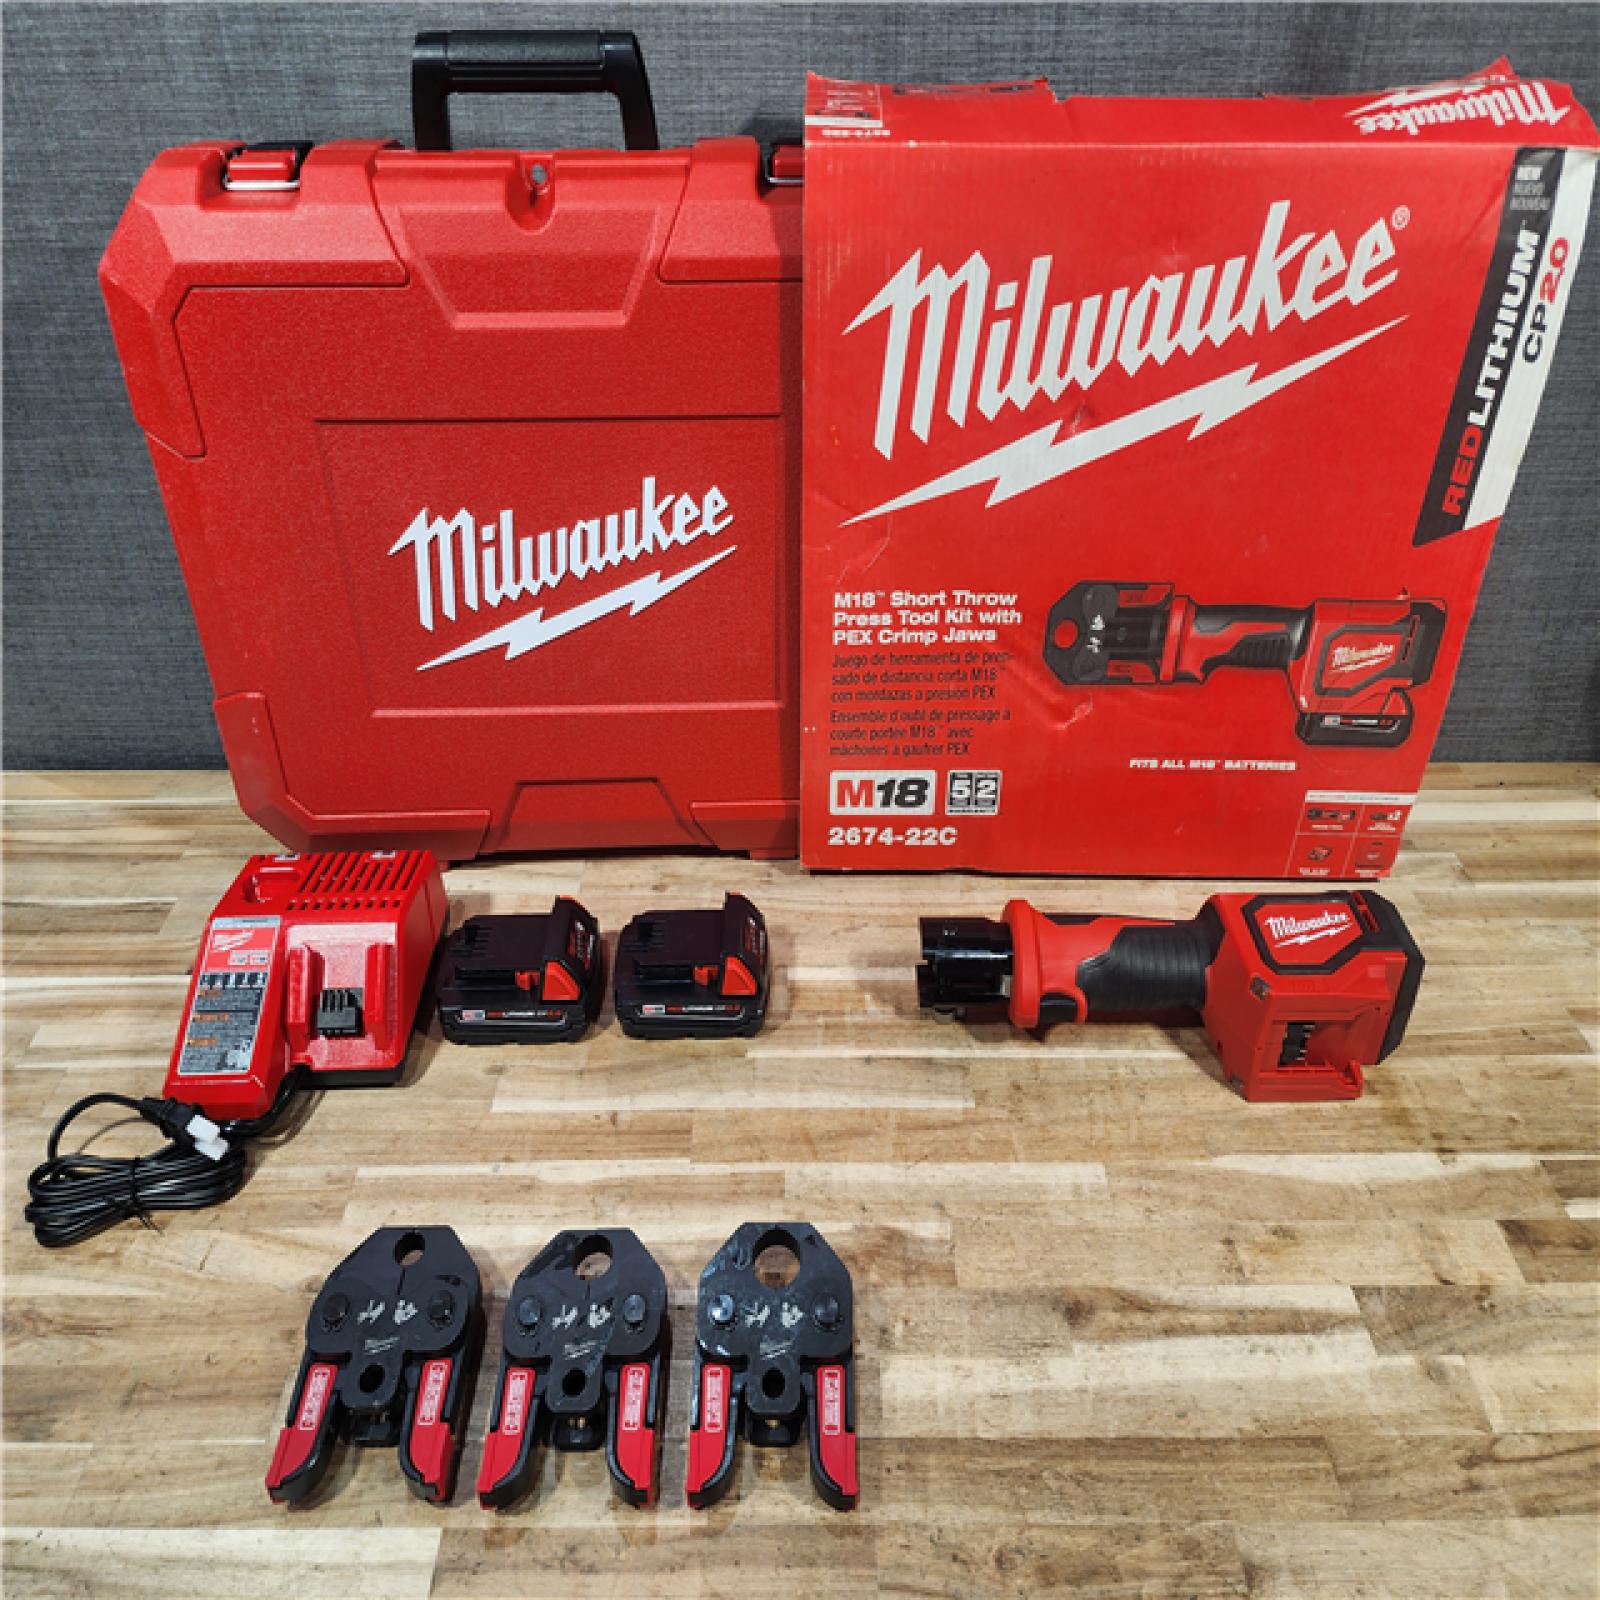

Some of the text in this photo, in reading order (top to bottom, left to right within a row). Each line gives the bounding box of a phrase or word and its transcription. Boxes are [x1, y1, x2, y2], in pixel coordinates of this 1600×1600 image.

[1353, 81, 1571, 136] Milwaukee
[1523, 237, 1569, 363] CP2.0
[387, 475, 734, 632] Milwaukee
[890, 590, 948, 606] Short
[952, 589, 1018, 606] Throw
[834, 607, 1022, 627] Press Tool Kit with
[833, 627, 998, 646] PEX Crimp Jaws
[832, 654, 868, 668] Juego
[872, 652, 886, 665] de
[889, 651, 961, 665] herramienta
[964, 651, 979, 664] de
[863, 670, 878, 684] de
[880, 669, 933, 684] distancia
[937, 669, 967, 683] corta
[832, 691, 853, 703] con
[855, 688, 912, 701] mordazas
[915, 688, 923, 700] a
[972, 686, 996, 700] PEX
[831, 710, 887, 723] Ensemble
[929, 708, 943, 721] de
[947, 727, 974, 739] avec
[947, 742, 970, 755] PEX
[1161, 759, 1186, 769] ALL
[837, 777, 930, 809] M18
[828, 826, 958, 846] 2674-22C
[1264, 909, 1350, 940] Milwaukee
